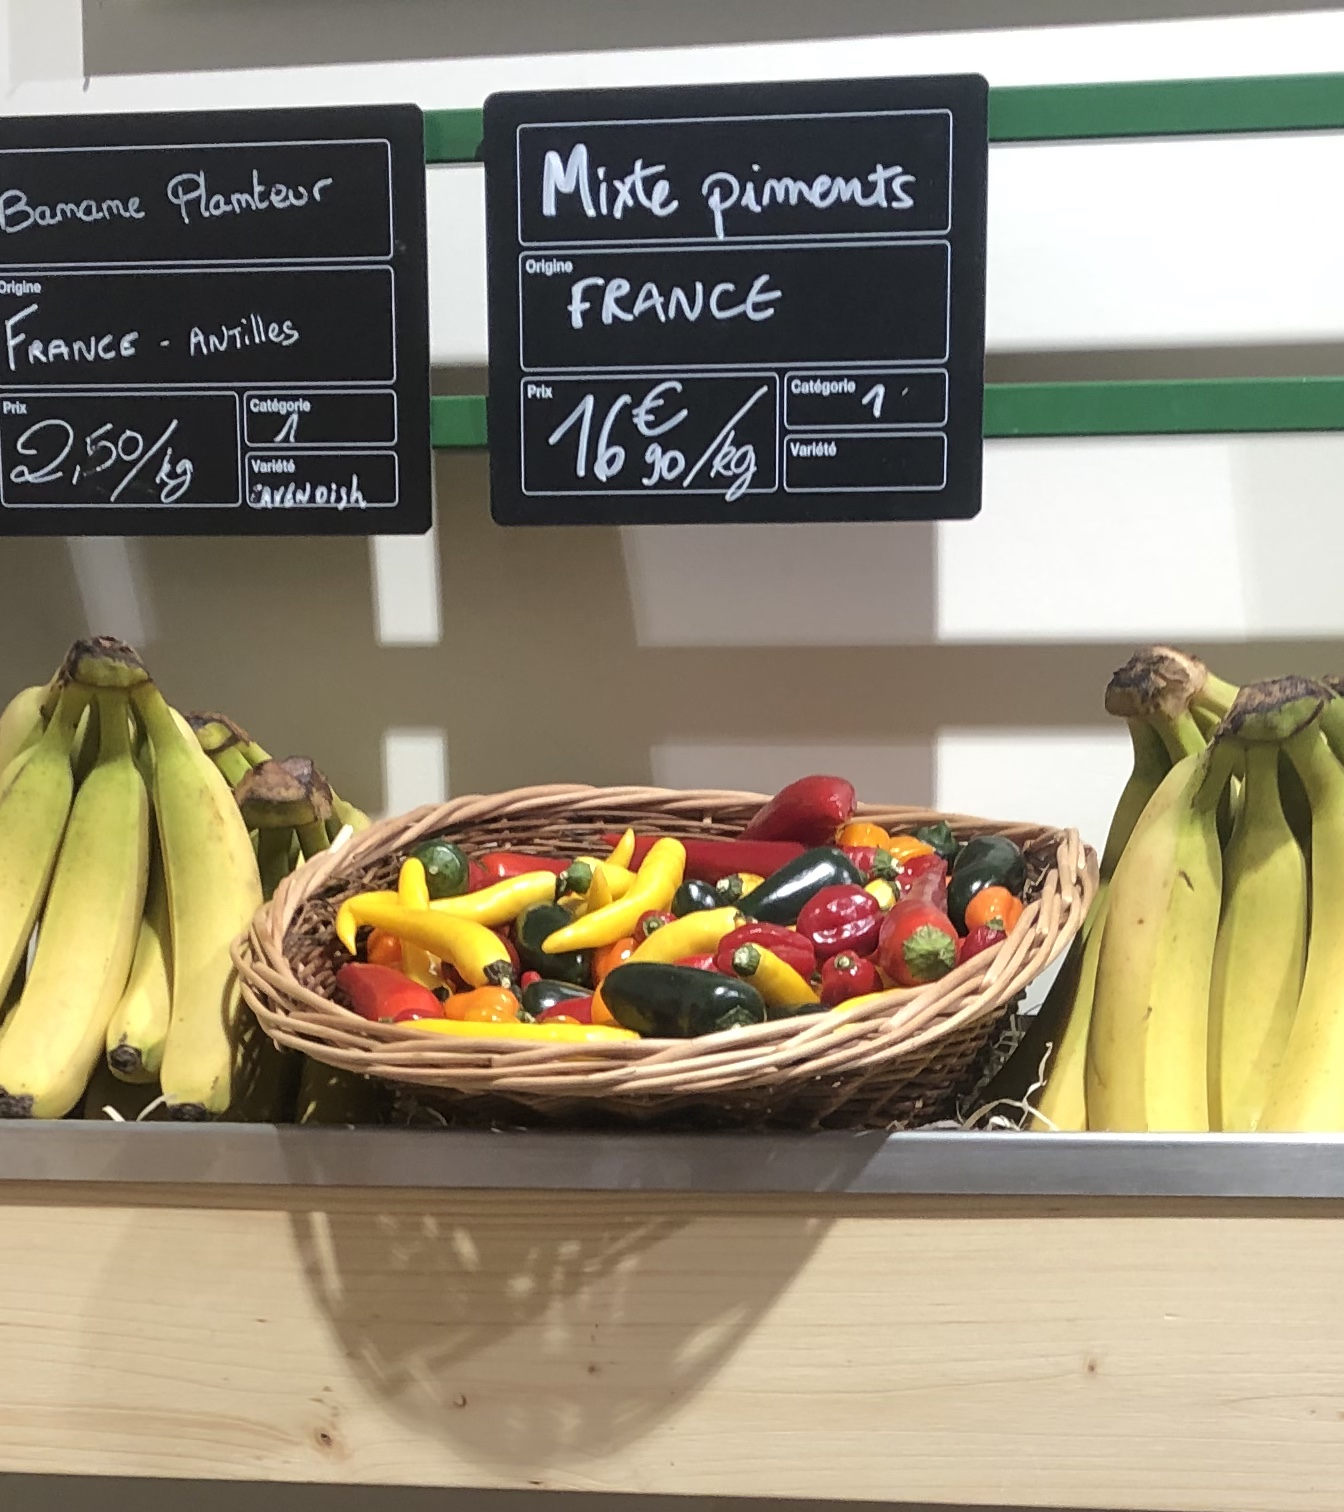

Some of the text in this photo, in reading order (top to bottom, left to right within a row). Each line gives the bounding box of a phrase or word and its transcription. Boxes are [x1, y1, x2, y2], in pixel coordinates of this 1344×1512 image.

[542, 143, 918, 239] Mixte piments
[525, 258, 573, 275] Origine
[567, 273, 783, 330] FRANCE
[3, 303, 139, 371] FRANCE
[527, 384, 553, 399] Prix
[790, 379, 856, 396] Catégorie
[2, 401, 27, 415] Prix
[249, 397, 310, 414] Catégorie
[860, 383, 885, 418] 1
[273, 413, 298, 443] 1
[790, 441, 837, 457] Variété
[251, 458, 296, 474] Variété
